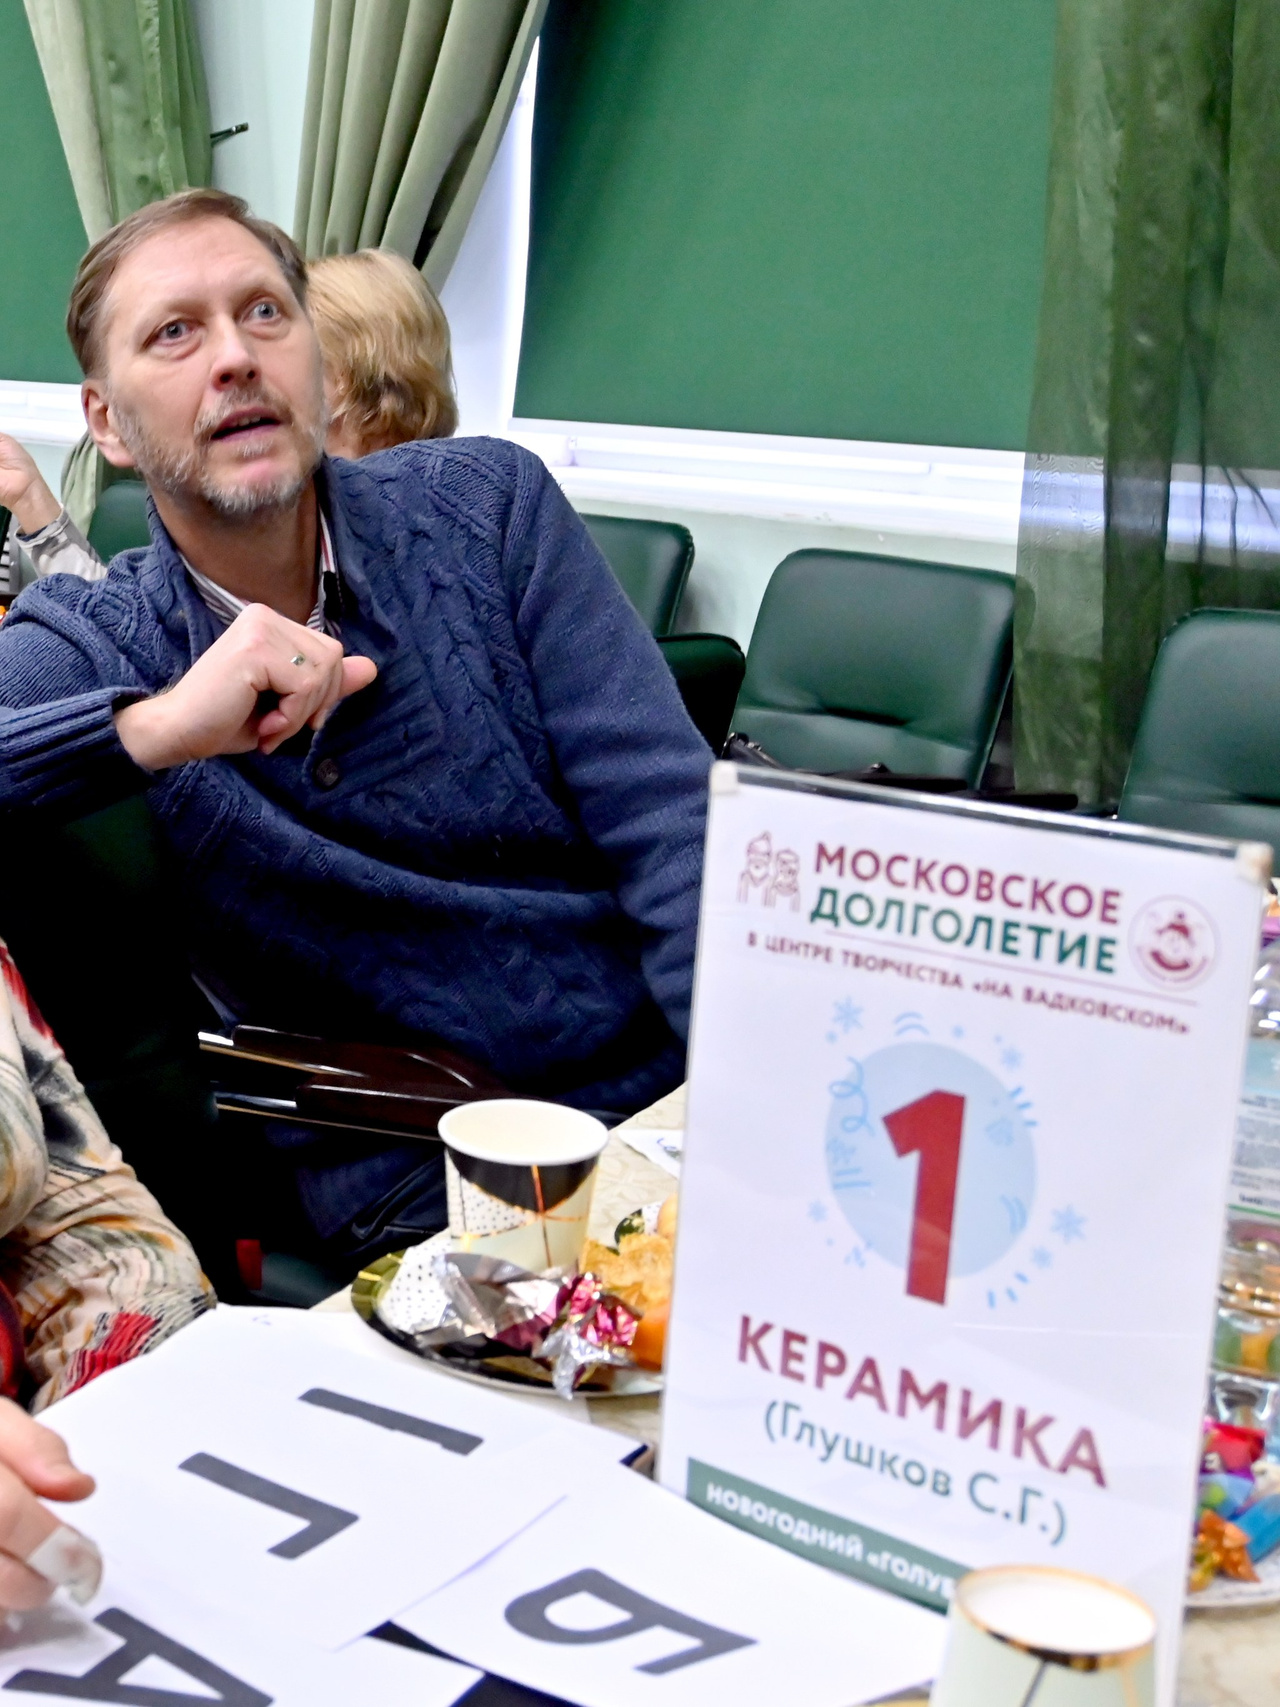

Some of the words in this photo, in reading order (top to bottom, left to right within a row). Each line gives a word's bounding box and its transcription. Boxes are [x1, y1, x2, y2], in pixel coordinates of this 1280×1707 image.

[809, 886, 1117, 975] ДОЛГОЛЕТИЕ
[813, 842, 1124, 926] МОСКОВСКОЕ
[746, 931, 759, 948] В
[764, 935, 834, 964] ЦЕНТРЕ
[841, 948, 964, 990] ТВОРЧЕСТВА
[972, 976, 1013, 1001] «НА
[1022, 985, 1191, 1036] ВАДКОВСКОМ»
[882, 1088, 966, 1307] 1
[738, 1314, 1108, 1489] КЕРАМИКА
[705, 1481, 864, 1562] НОВОГОДНИЙ
[764, 1400, 953, 1499] (Глушков
[967, 1471, 1068, 1547] С.Г.)
